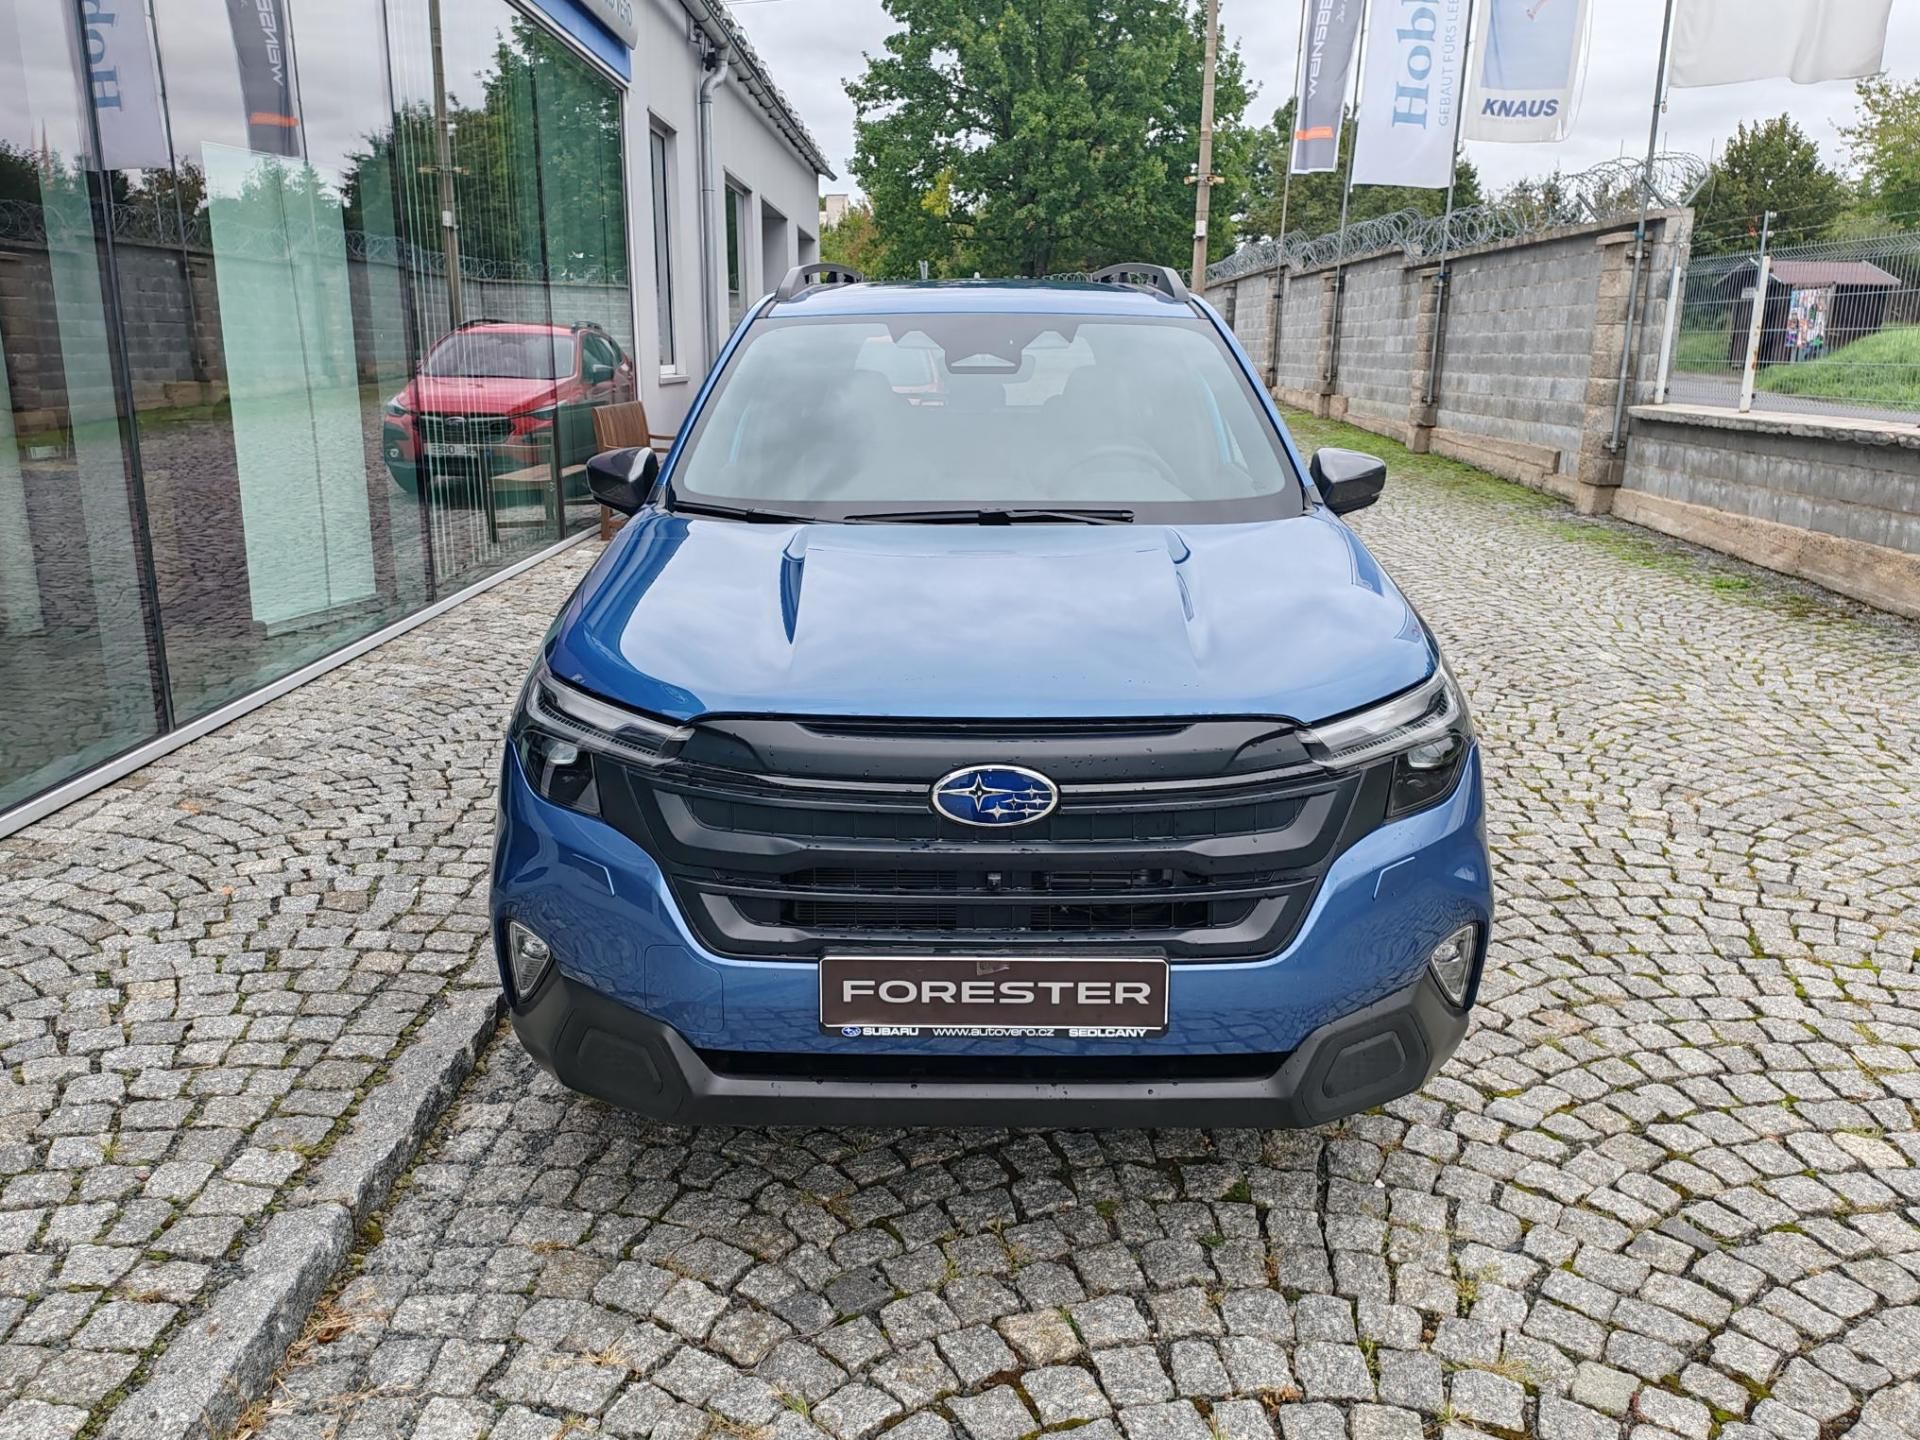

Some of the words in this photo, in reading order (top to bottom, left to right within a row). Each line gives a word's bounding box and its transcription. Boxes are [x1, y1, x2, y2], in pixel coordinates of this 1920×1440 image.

[1391, 0, 1440, 130] Hob
[1438, 66, 1453, 127] GEBAUT
[1481, 98, 1560, 118] KNAUS
[842, 980, 1152, 1006] FORESTER
[862, 1026, 919, 1037] SUBARU
[932, 1027, 1055, 1038] www.autovero.cz
[1068, 1027, 1148, 1038] SEDLCANY
